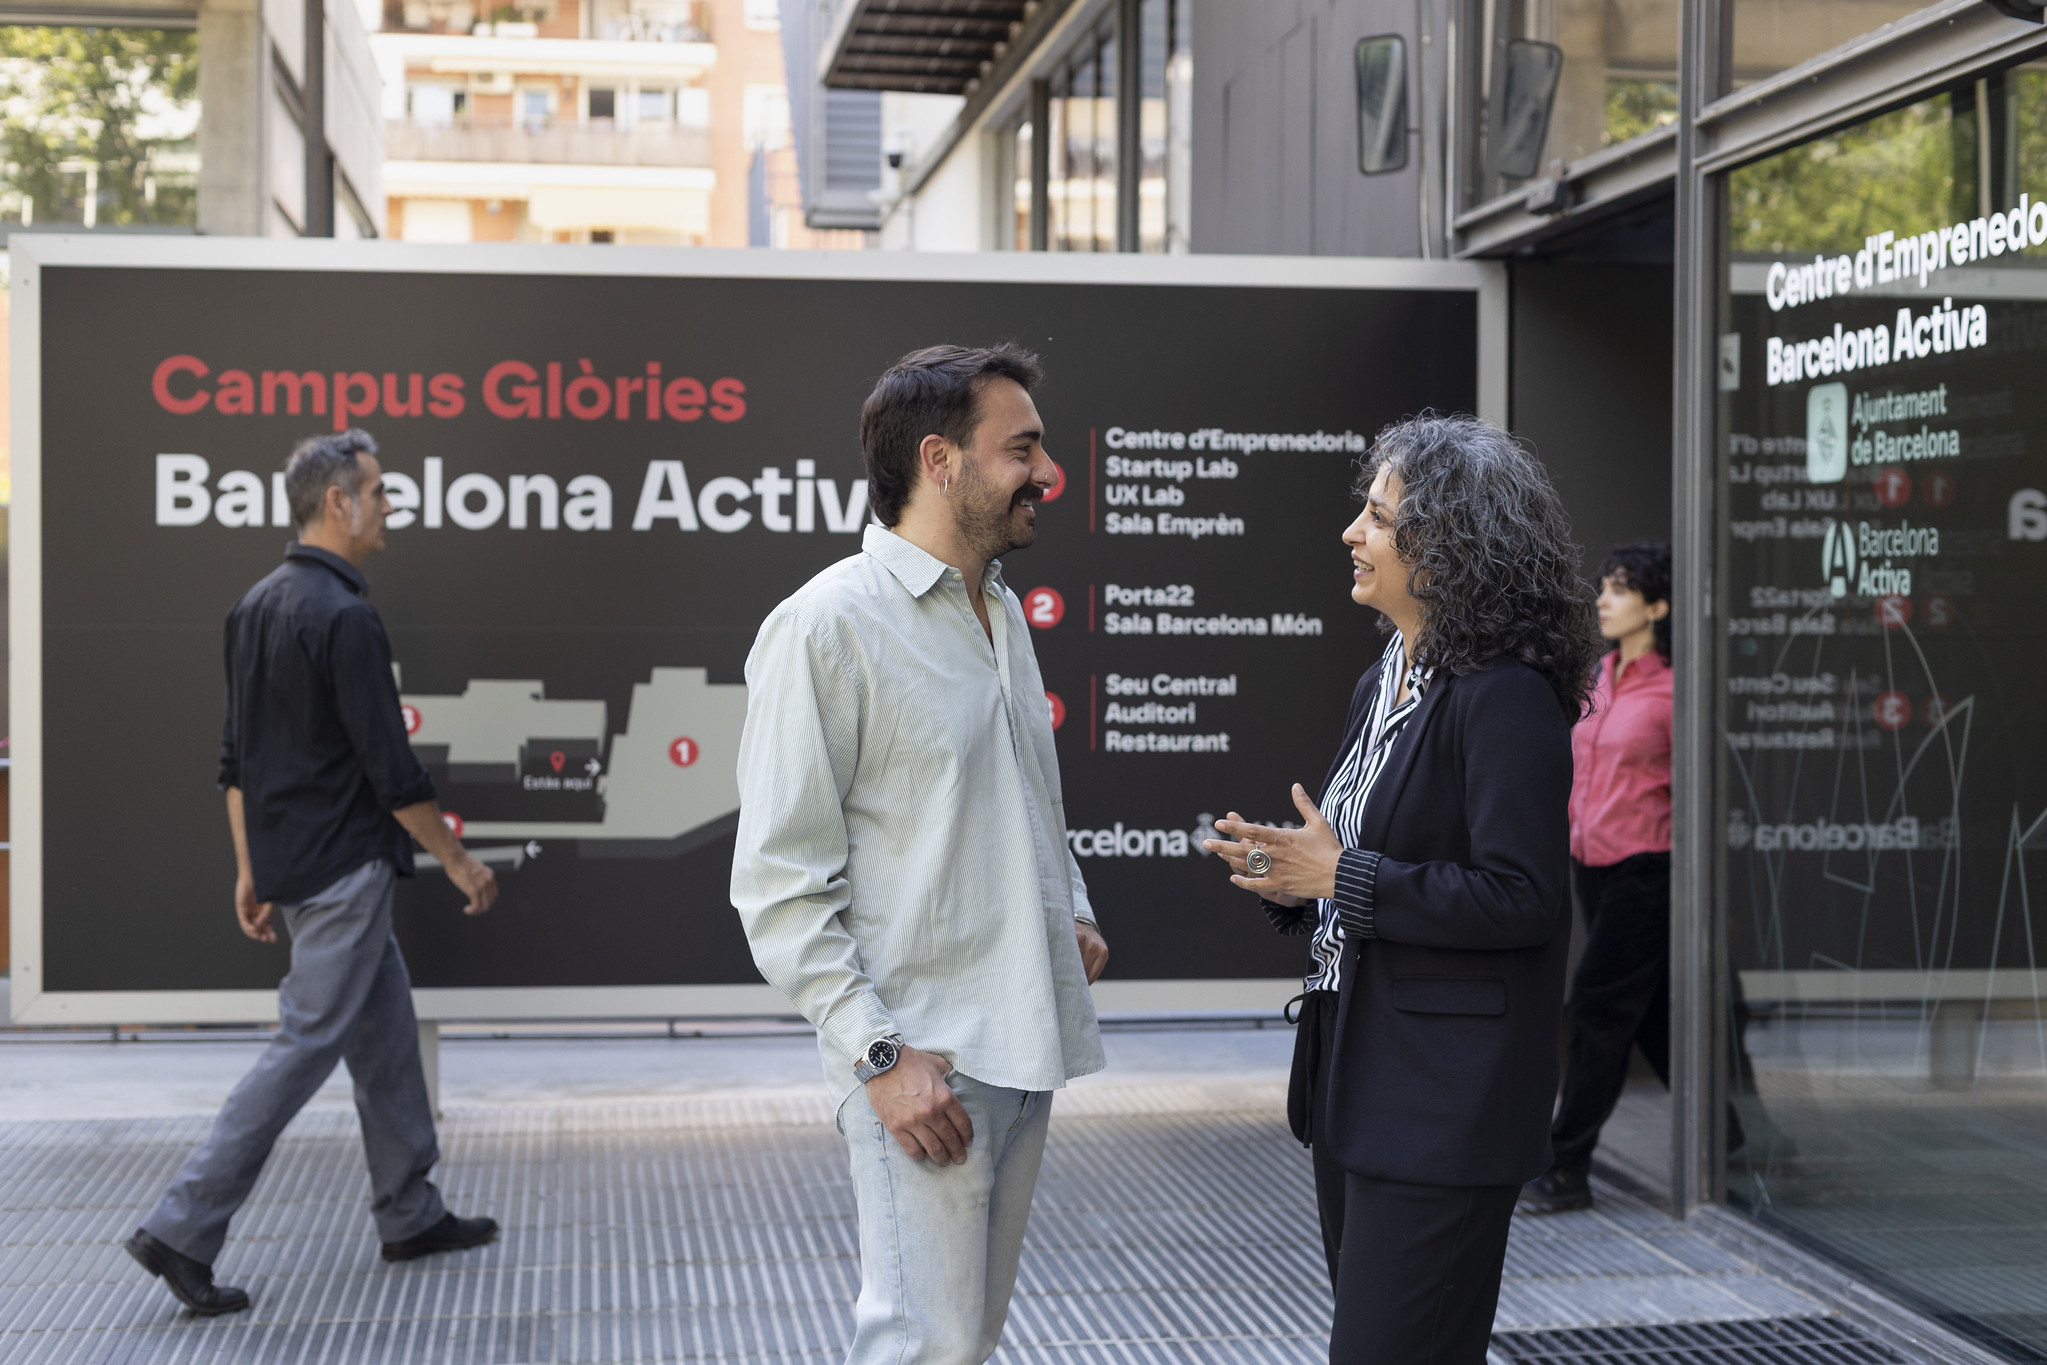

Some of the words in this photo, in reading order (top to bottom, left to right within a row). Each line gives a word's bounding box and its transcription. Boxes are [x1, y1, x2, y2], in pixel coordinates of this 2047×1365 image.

[1766, 254, 1853, 311] Centre
[1766, 323, 1890, 386] Barcelona
[1893, 296, 1988, 362] Activa
[151, 354, 466, 431] Campus
[481, 358, 747, 423] Glòries
[1851, 383, 1948, 432] Ajuntament
[1105, 427, 1186, 449] Centre
[1851, 435, 1872, 466] de
[1874, 426, 1960, 461] Barcelona
[1105, 456, 1193, 482] Startup
[1196, 458, 1239, 478] Lab
[155, 453, 612, 531] Barelona
[631, 459, 873, 534] Activ
[1105, 484, 1139, 505] UX
[1142, 485, 1185, 506] Lab
[1105, 512, 1154, 534] Sala
[1157, 513, 1245, 539] Emprèn
[1859, 519, 1939, 558] Barcelona
[1857, 560, 1912, 597] Activa
[1032, 593, 1055, 622] 2
[1105, 584, 1195, 607] Porta22
[1105, 612, 1153, 635] Sala
[1156, 613, 1268, 635] Barcelona
[1271, 612, 1323, 635] Món
[1105, 673, 1149, 696] Seu
[1151, 673, 1237, 696] Central
[1105, 701, 1196, 724] Auditori
[676, 741, 690, 763] 1
[1105, 730, 1230, 753] Restaurant
[1066, 822, 1189, 857] rcelona
